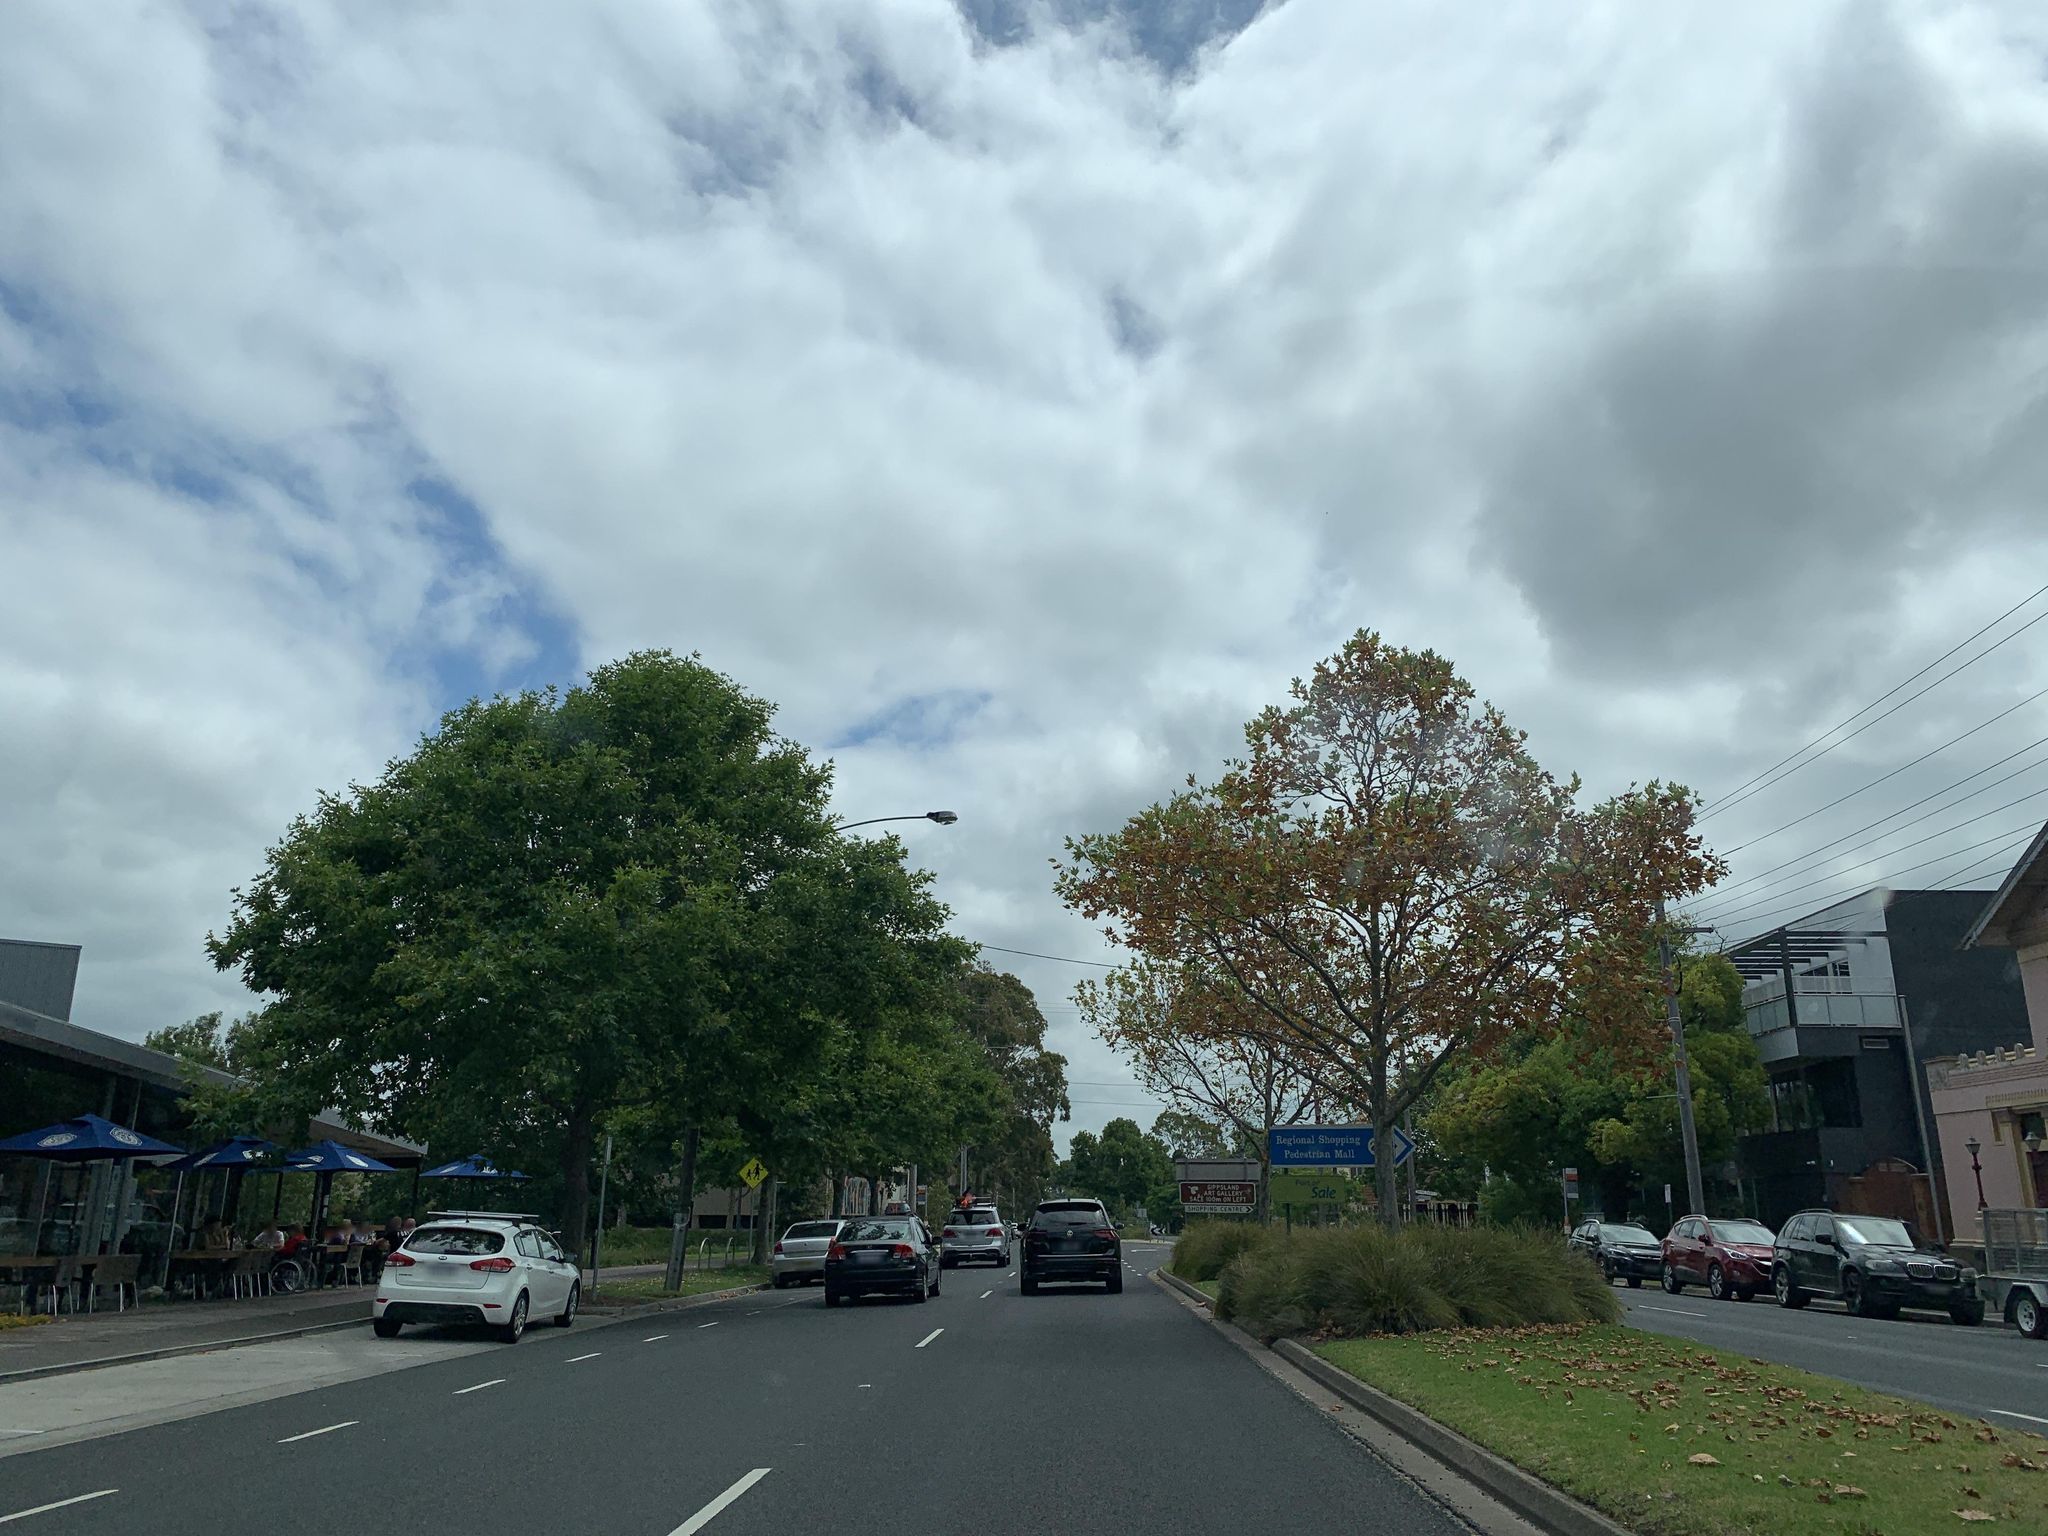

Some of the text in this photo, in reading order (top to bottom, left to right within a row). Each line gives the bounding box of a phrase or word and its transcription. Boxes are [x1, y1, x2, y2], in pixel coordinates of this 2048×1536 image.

[1276, 1135, 1361, 1146] Regional Shopping
[1284, 1150, 1355, 1159] Pedestrian Mall
[1311, 1186, 1337, 1199] Sale
